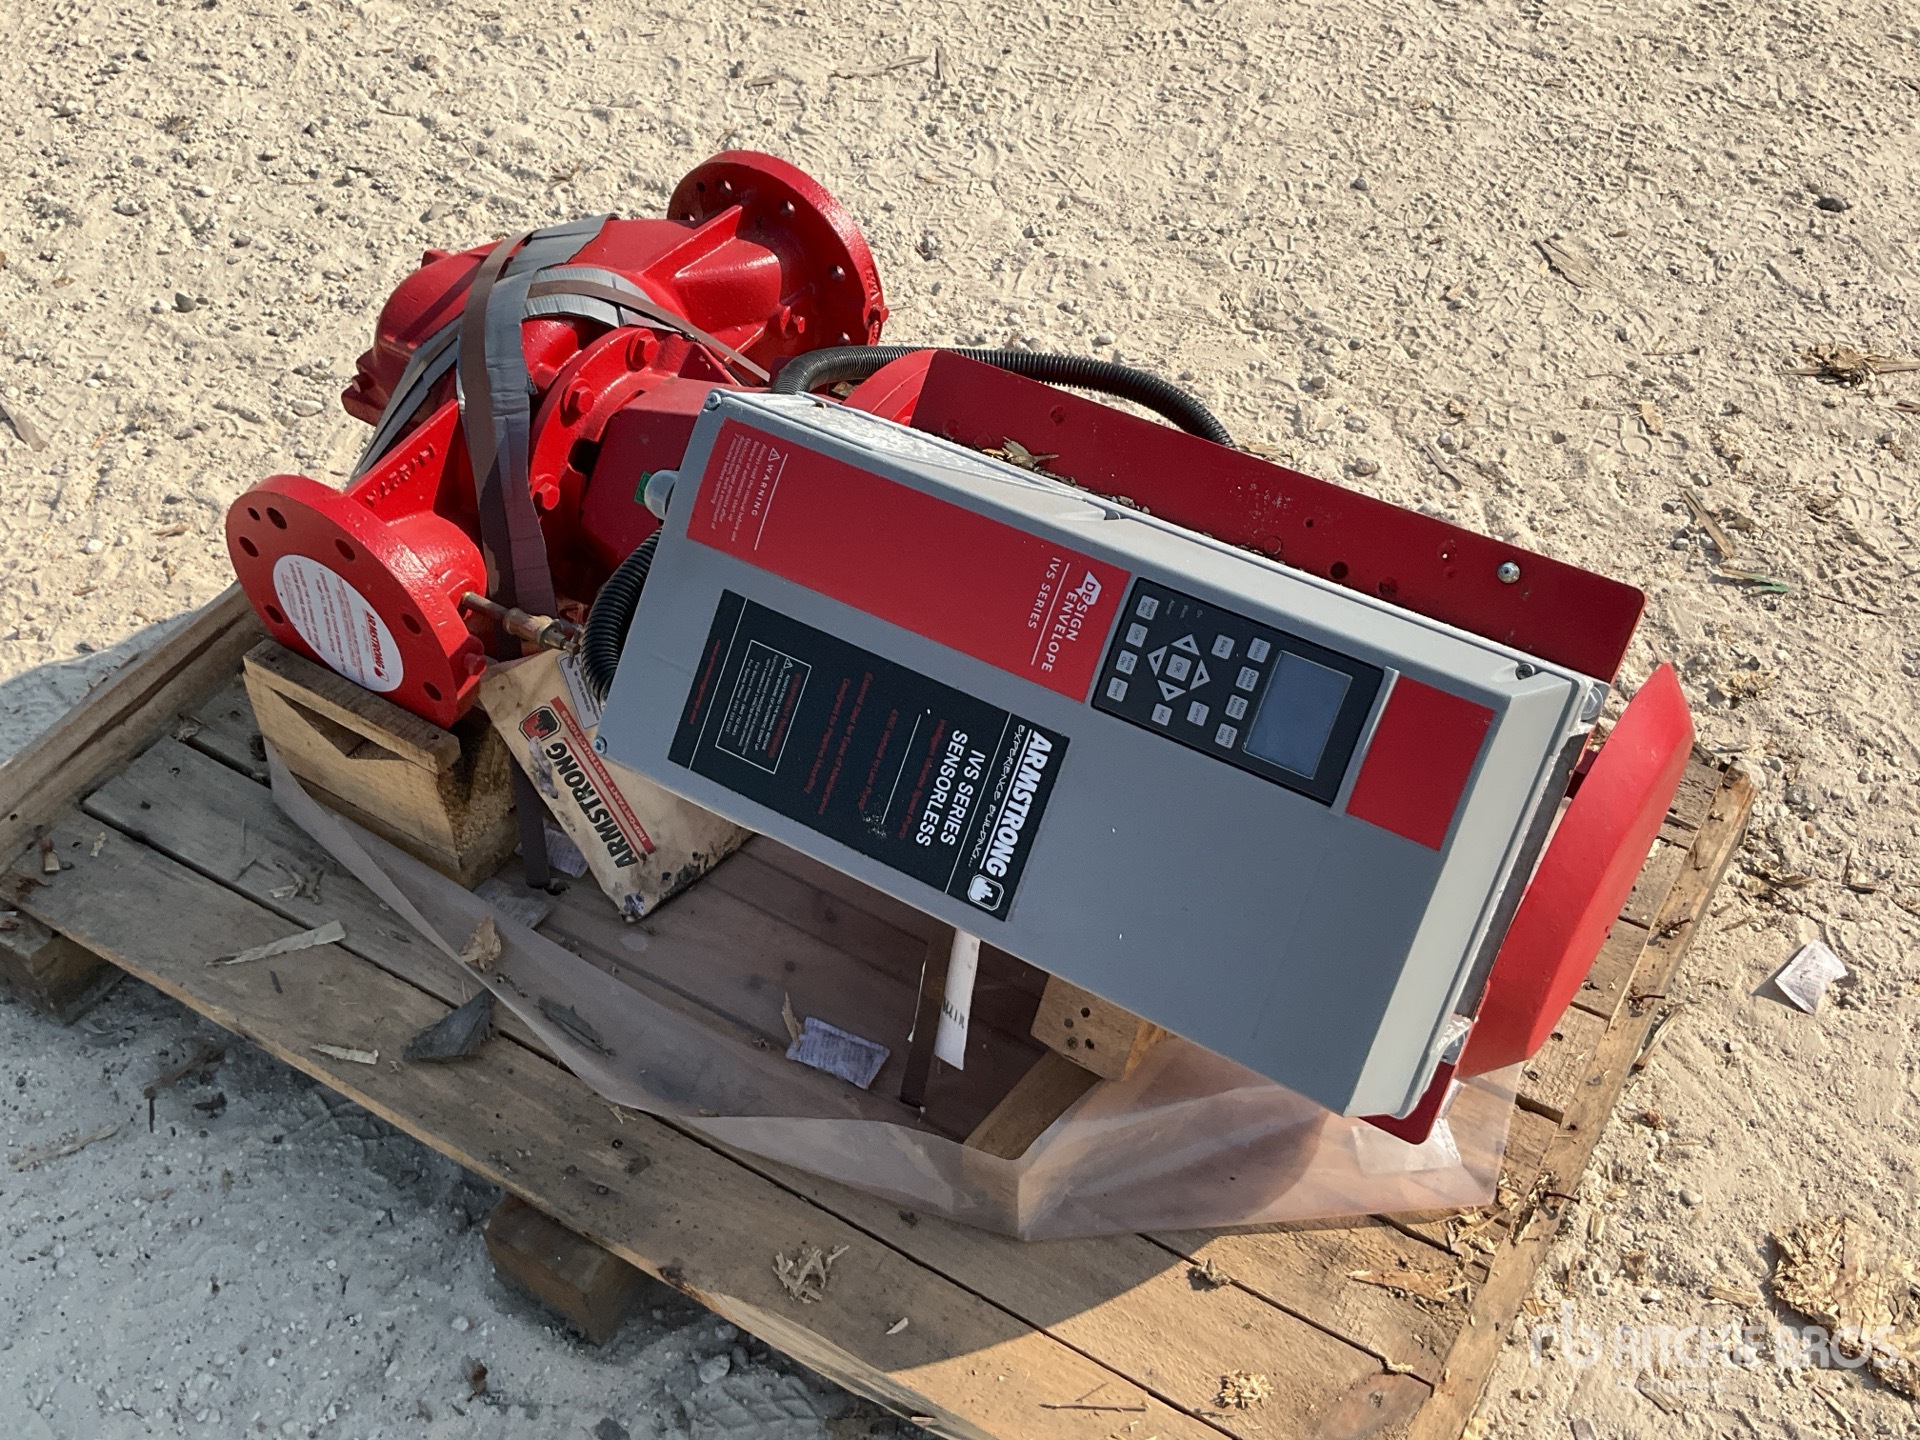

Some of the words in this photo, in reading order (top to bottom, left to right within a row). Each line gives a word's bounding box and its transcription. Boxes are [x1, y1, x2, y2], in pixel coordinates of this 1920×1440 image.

[725, 437, 736, 461] minutes
[737, 437, 750, 464] Electrical
[747, 440, 758, 462] Beware
[754, 443, 766, 465] Always
[718, 461, 728, 480] before
[729, 463, 741, 485] danger
[750, 465, 758, 479] read
[710, 480, 722, 504] opening
[734, 469, 748, 498] automatic
[746, 479, 754, 489] the
[750, 463, 773, 517] WARNING
[730, 499, 738, 512] start
[740, 489, 751, 512] manual
[718, 508, 726, 522] after
[733, 511, 743, 530] before
[1045, 556, 1061, 580] IVS
[1027, 582, 1051, 629] SERIES
[1064, 580, 1096, 642] DESIGN
[365, 609, 384, 669] ARMSTRONG
[1040, 590, 1078, 673] ENVELOPE
[1119, 656, 1126, 665] On
[1252, 640, 1264, 659] Status
[1124, 656, 1134, 670] Auto
[1173, 661, 1182, 672] OK
[1244, 670, 1256, 688] Quick
[1227, 697, 1237, 714] Menu
[1235, 701, 1244, 716] Main
[559, 707, 611, 785] INSTRUCTIONS
[1224, 728, 1234, 745] Alarm
[962, 748, 985, 780] IVS
[991, 723, 1025, 802] EXPERIENCE
[914, 728, 969, 847] SENSORLESS
[543, 736, 638, 873] ARMSTRONG
[607, 783, 647, 842] IMPORTANT
[938, 780, 974, 846] SERIES
[982, 729, 1054, 880] ARMSTRONG
